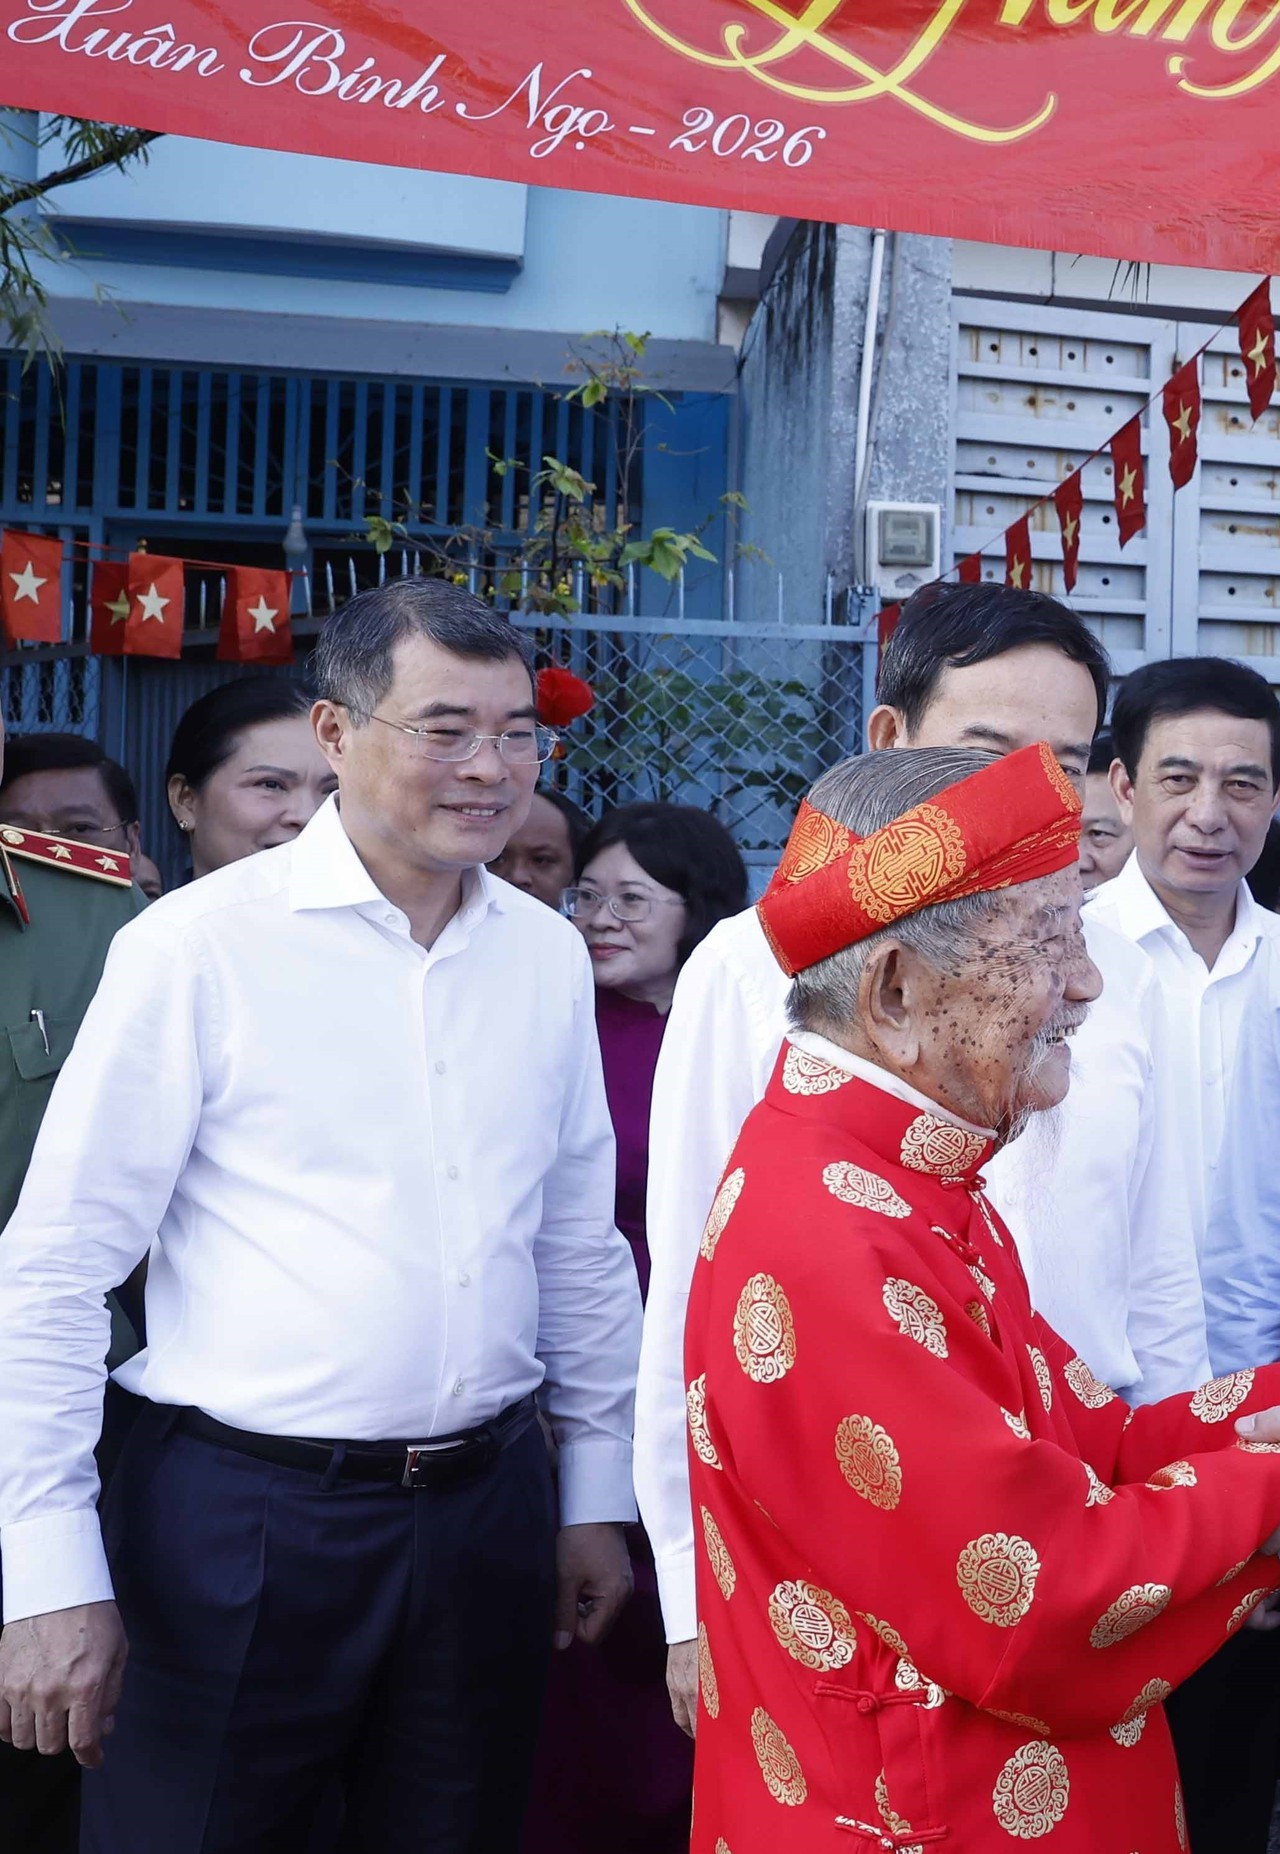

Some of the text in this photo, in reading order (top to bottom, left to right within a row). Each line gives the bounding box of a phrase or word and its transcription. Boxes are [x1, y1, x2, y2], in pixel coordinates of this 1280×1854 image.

[7, 0, 225, 77] Xuân
[455, 62, 615, 158] Ngọ
[669, 106, 826, 167] 2026
